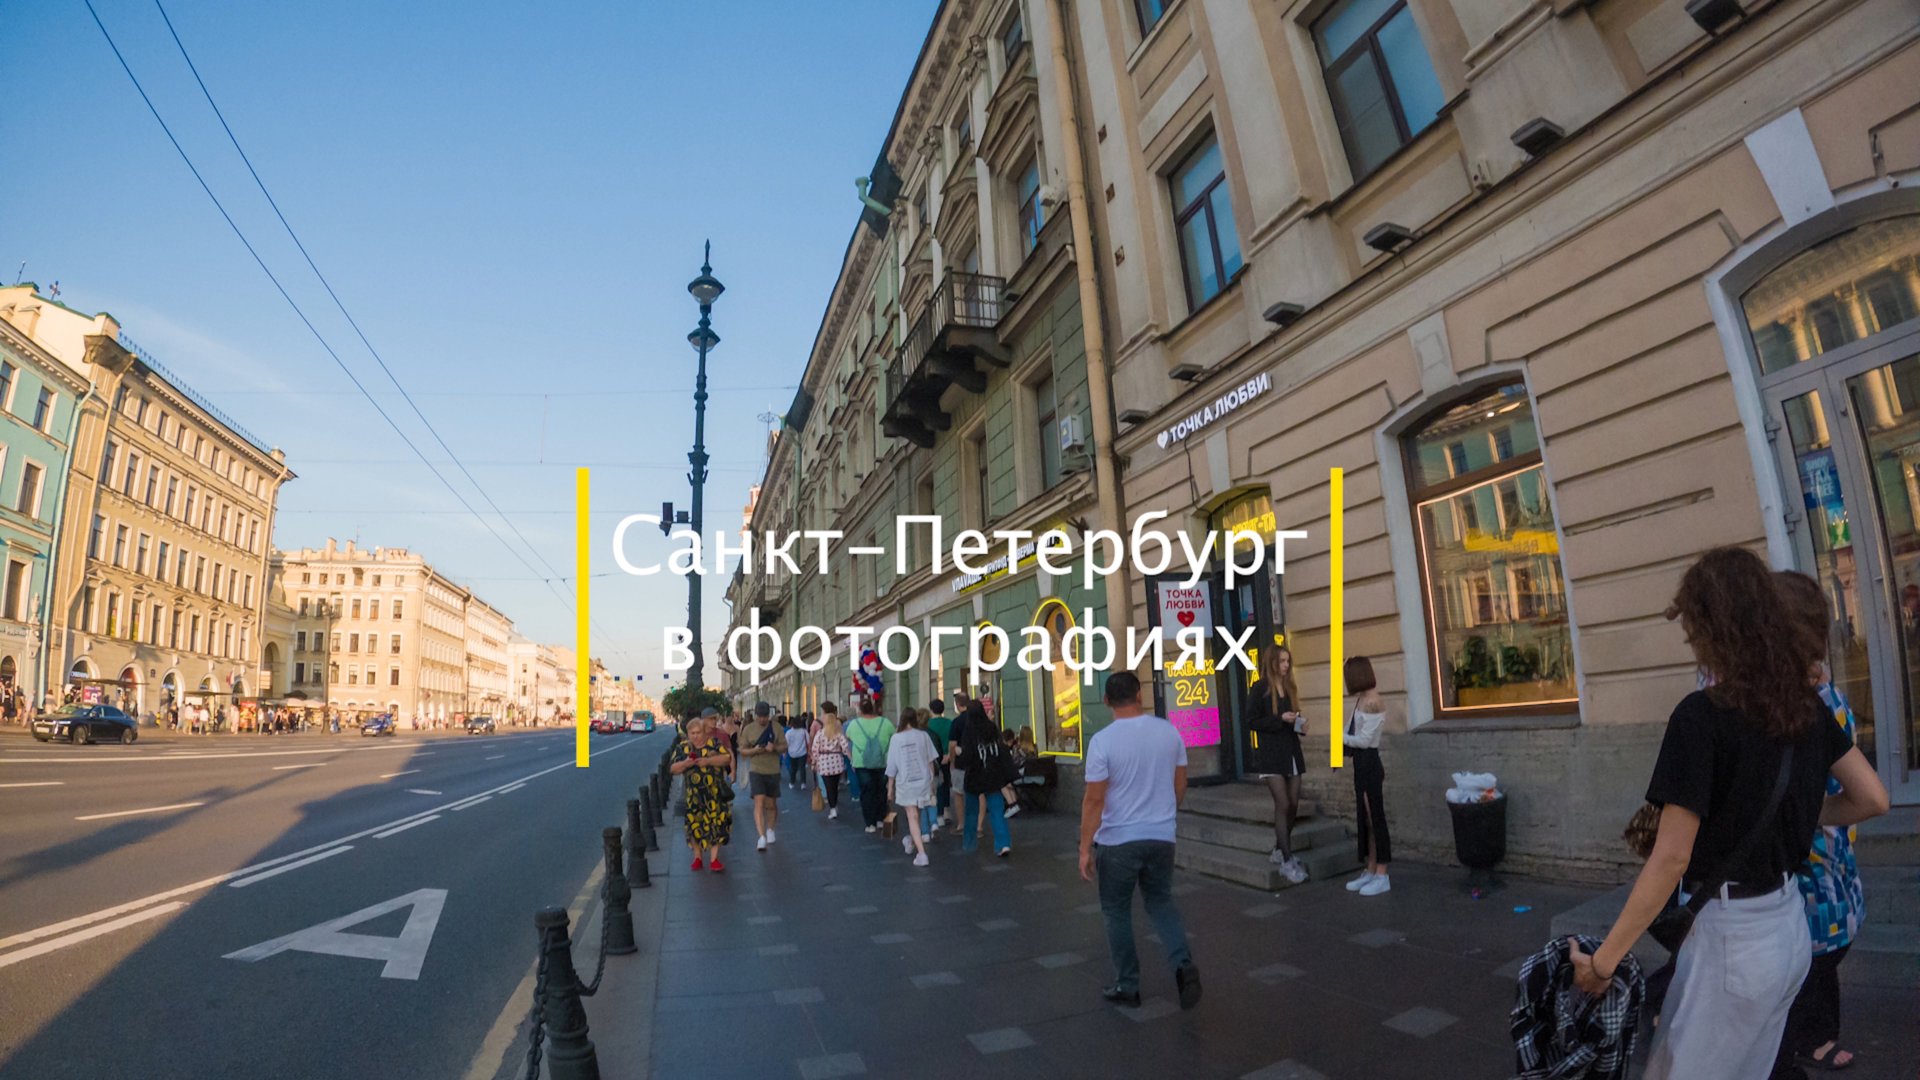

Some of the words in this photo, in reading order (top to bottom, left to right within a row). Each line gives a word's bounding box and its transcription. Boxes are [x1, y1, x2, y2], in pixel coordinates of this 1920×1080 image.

[1169, 406, 1213, 443] ТОЧКА
[1214, 372, 1270, 418] ЛЮБВИ
[1809, 465, 1833, 486] TAX
[1165, 589, 1203, 599] ТОЧКА
[1165, 599, 1206, 610] ЛЮБВИ
[1175, 678, 1209, 707] 24
